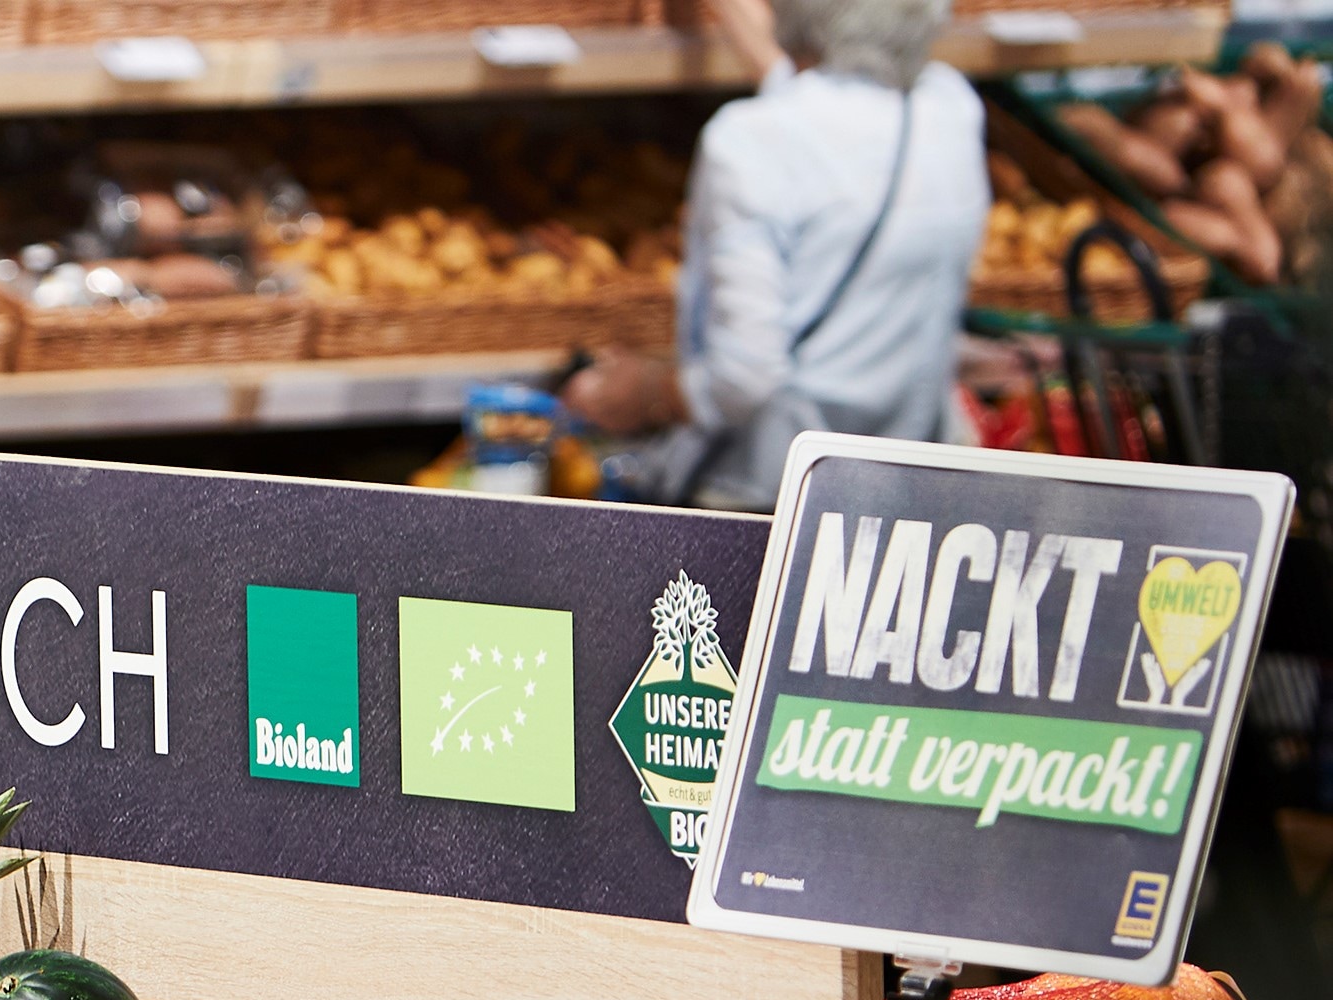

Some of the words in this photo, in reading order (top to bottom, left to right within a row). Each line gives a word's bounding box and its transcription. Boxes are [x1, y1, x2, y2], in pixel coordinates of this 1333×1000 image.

[788, 511, 1124, 703] NACKT
[1148, 579, 1235, 617] UMWELT
[255, 717, 354, 774] Bioland
[769, 708, 909, 789] statt
[910, 736, 1194, 826] verpackt!
